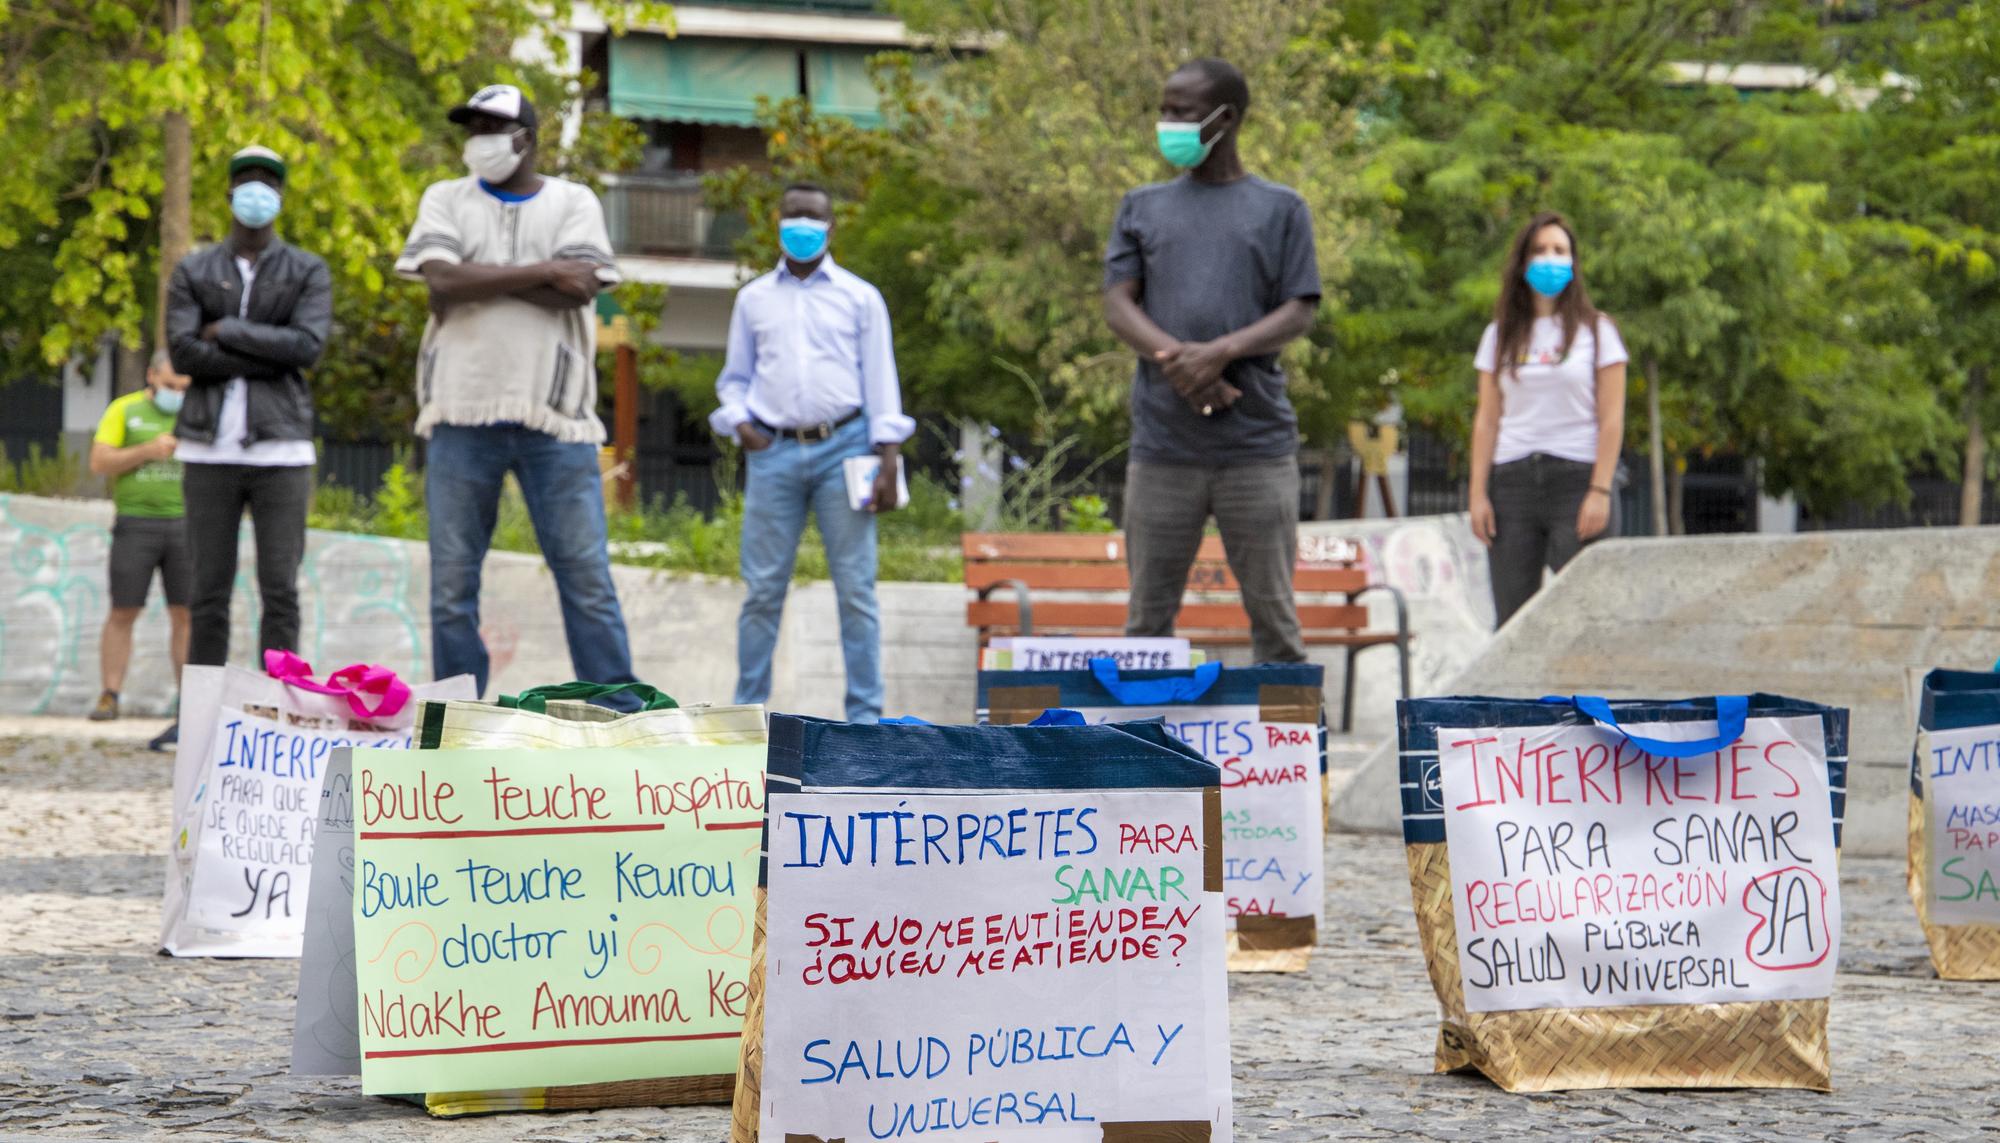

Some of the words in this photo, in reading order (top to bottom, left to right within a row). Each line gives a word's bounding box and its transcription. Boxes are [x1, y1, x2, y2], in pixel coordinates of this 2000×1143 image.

[1265, 725, 1312, 748] PARA
[1930, 740, 2000, 778] INT
[221, 774, 264, 807] PARA
[272, 784, 309, 813] QUE
[361, 769, 463, 826] Boule
[483, 766, 611, 821] teuche
[1221, 757, 1307, 788] SANAR
[207, 800, 227, 830] SE
[782, 800, 1099, 868] INTÉRPRETES
[1119, 823, 1199, 855] PARA
[1228, 825, 1298, 842] TODAS
[1496, 820, 1612, 878] PARA
[1653, 810, 1812, 867] SANAR
[230, 866, 292, 919] YA
[361, 858, 449, 918] Boule
[614, 851, 735, 903] Keurou
[1051, 863, 1191, 907] SANAR
[804, 912, 855, 948] SI
[860, 914, 923, 951] NO
[985, 903, 1202, 946] ENTIENDEN
[1751, 874, 1814, 957] YA
[442, 921, 568, 969] doctor
[584, 913, 619, 980] yi
[1466, 930, 1567, 990] SALUD
[1582, 955, 1750, 996] UNIVERSAL
[532, 981, 691, 1031] Amouma
[800, 1034, 952, 1086] SALUD
[967, 1021, 1136, 1077] PÚBLICA
[1151, 1022, 1185, 1066] Y
